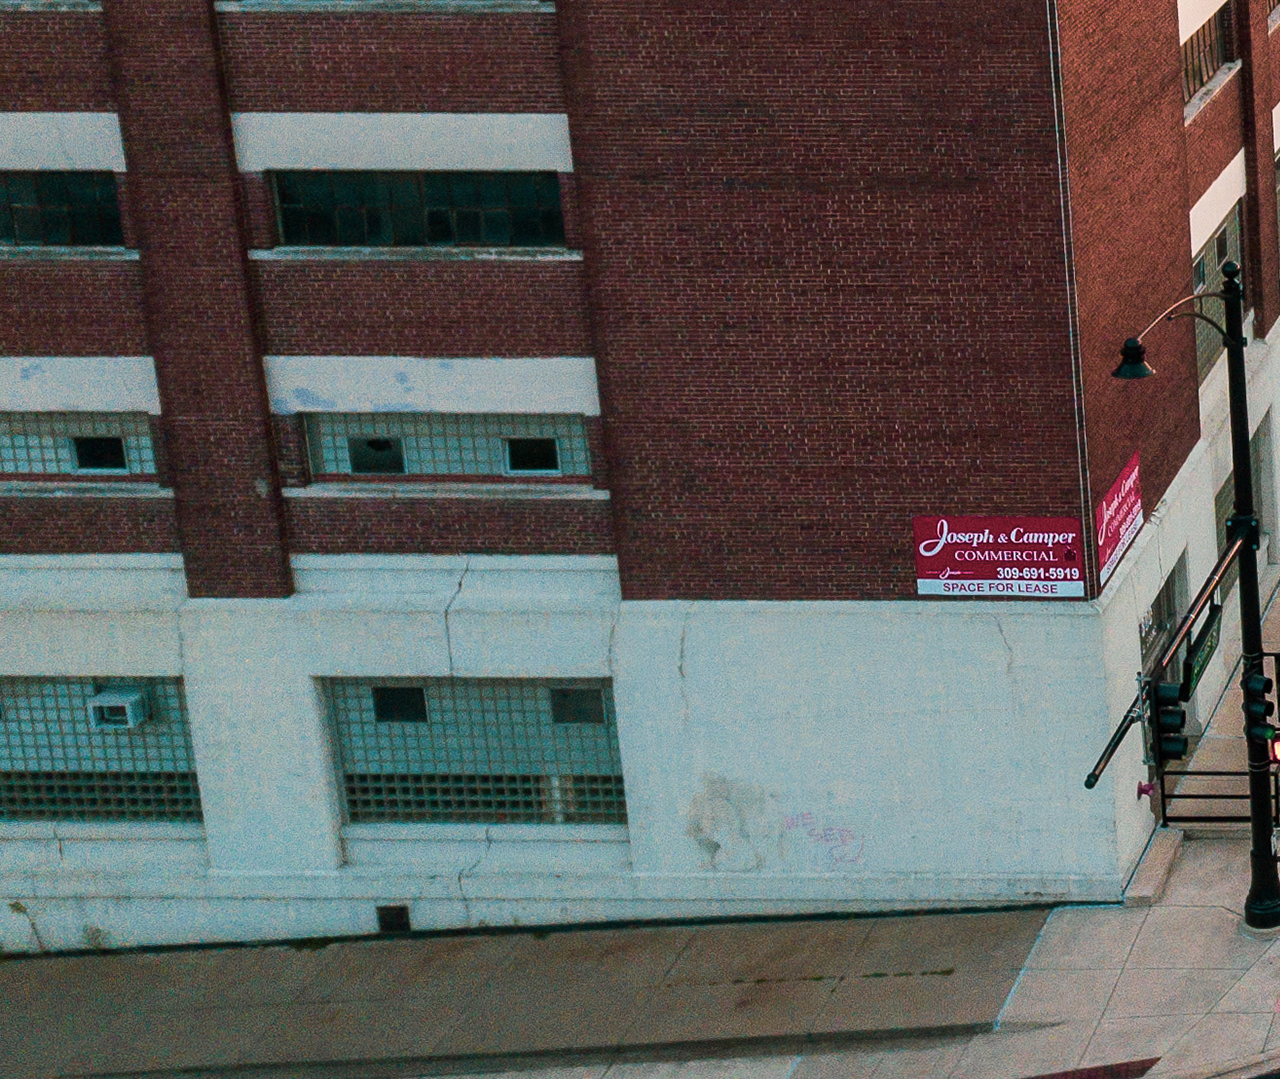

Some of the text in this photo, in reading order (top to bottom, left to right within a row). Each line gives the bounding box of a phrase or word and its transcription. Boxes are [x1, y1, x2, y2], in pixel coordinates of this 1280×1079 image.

[918, 519, 1076, 557] Joseph & Camper
[954, 550, 1058, 561] COMMERCIAL
[996, 567, 1080, 579] 309-691-5919
[943, 582, 1058, 593] SPACE FOR LEASE
